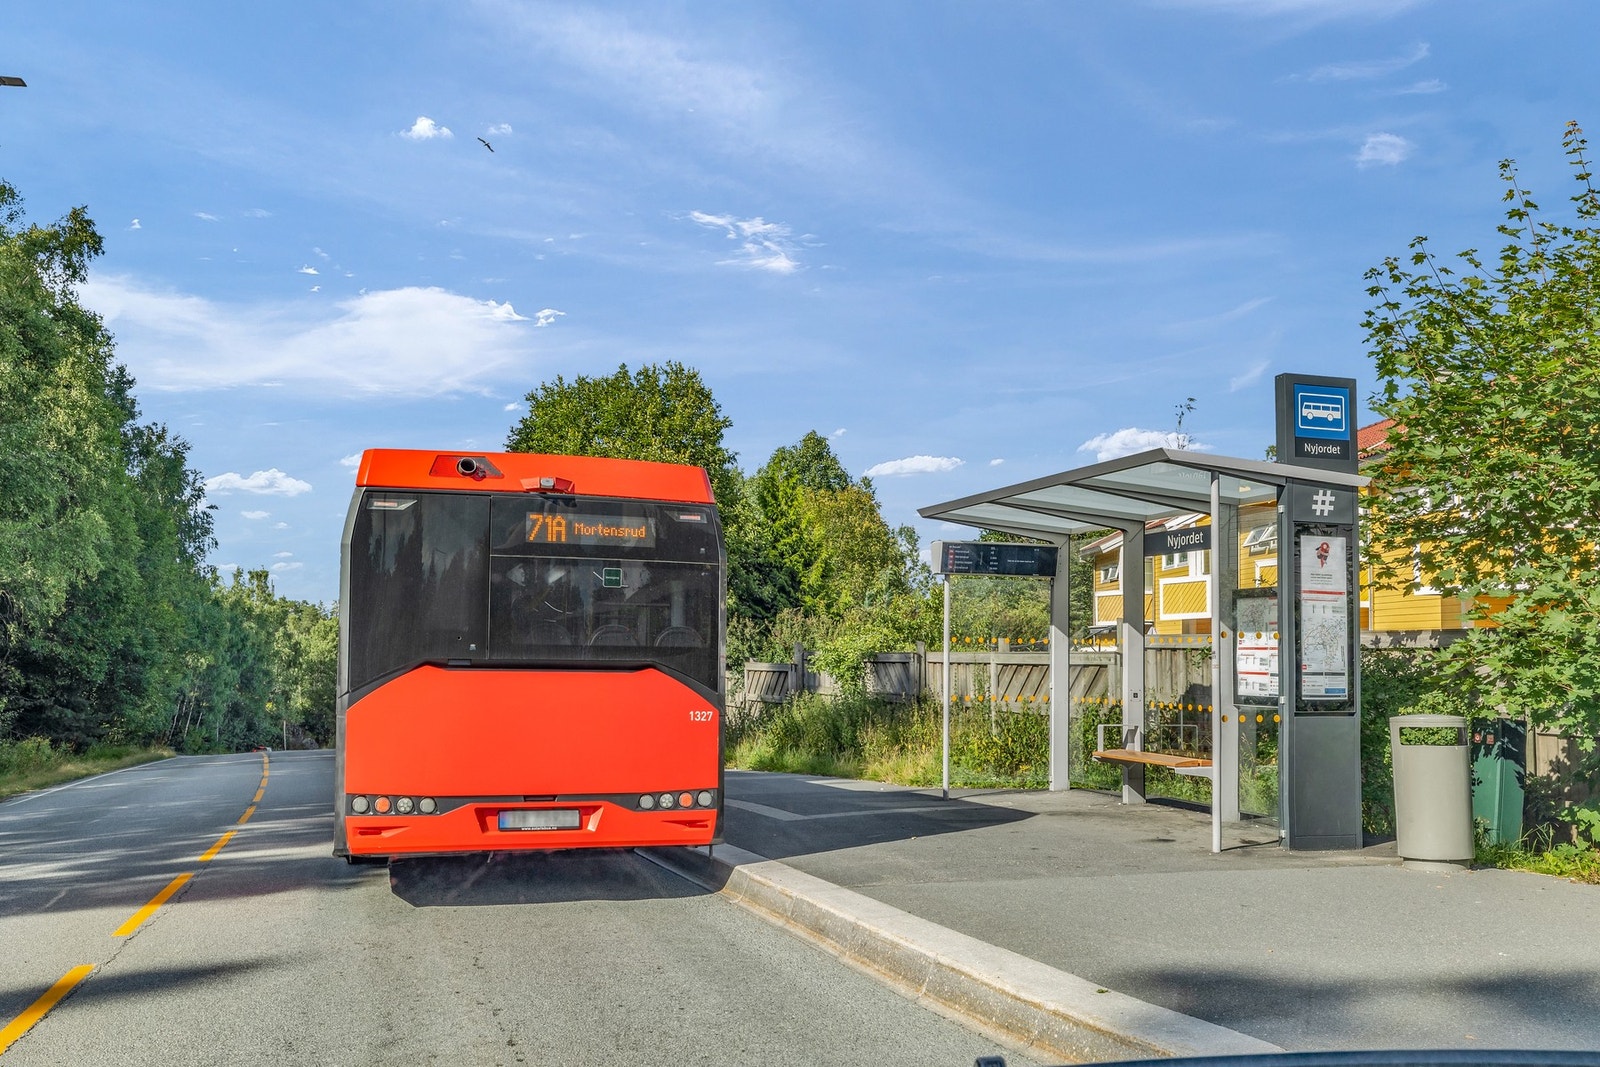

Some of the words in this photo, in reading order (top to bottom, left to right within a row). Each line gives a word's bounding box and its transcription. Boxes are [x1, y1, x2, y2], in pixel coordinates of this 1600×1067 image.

[1304, 442, 1341, 455] Nyjordet
[529, 514, 566, 542] 71A
[574, 522, 646, 538] Mortensrud
[1167, 531, 1204, 550] Nyjordet
[689, 710, 713, 722] 1327
